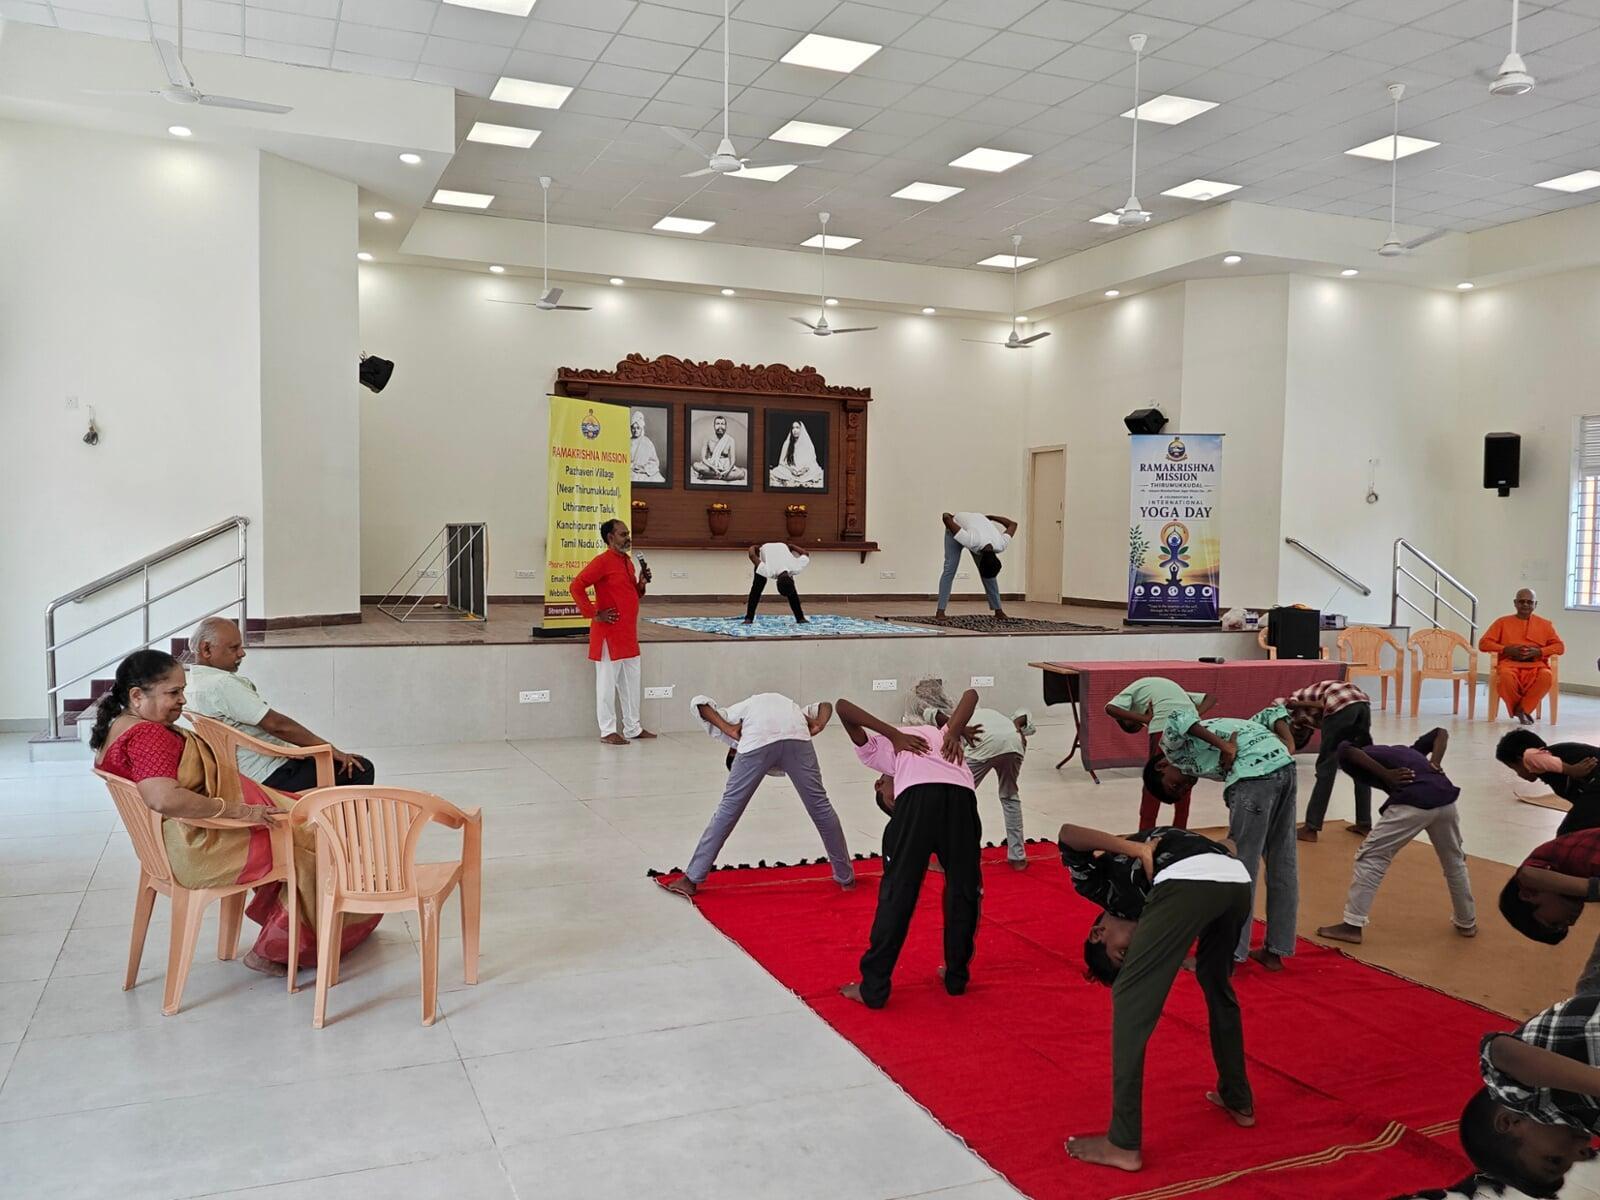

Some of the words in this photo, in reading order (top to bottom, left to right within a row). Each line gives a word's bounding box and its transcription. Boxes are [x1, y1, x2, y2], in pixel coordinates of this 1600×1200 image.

[552, 446, 600, 461] RAMAKRISHNA
[601, 451, 628, 463] MISSION
[1140, 463, 1215, 472] RAMAKRISHNA
[595, 468, 614, 481] Village
[1155, 473, 1198, 481] MISSION
[556, 482, 575, 495] (Near
[1140, 506, 1180, 518] YOGA
[1185, 506, 1212, 518] DAY
[556, 520, 596, 532] Kanchipuram
[561, 539, 576, 549] Tamil
[578, 539, 595, 549] Nadu
[548, 607, 570, 616] Strength
